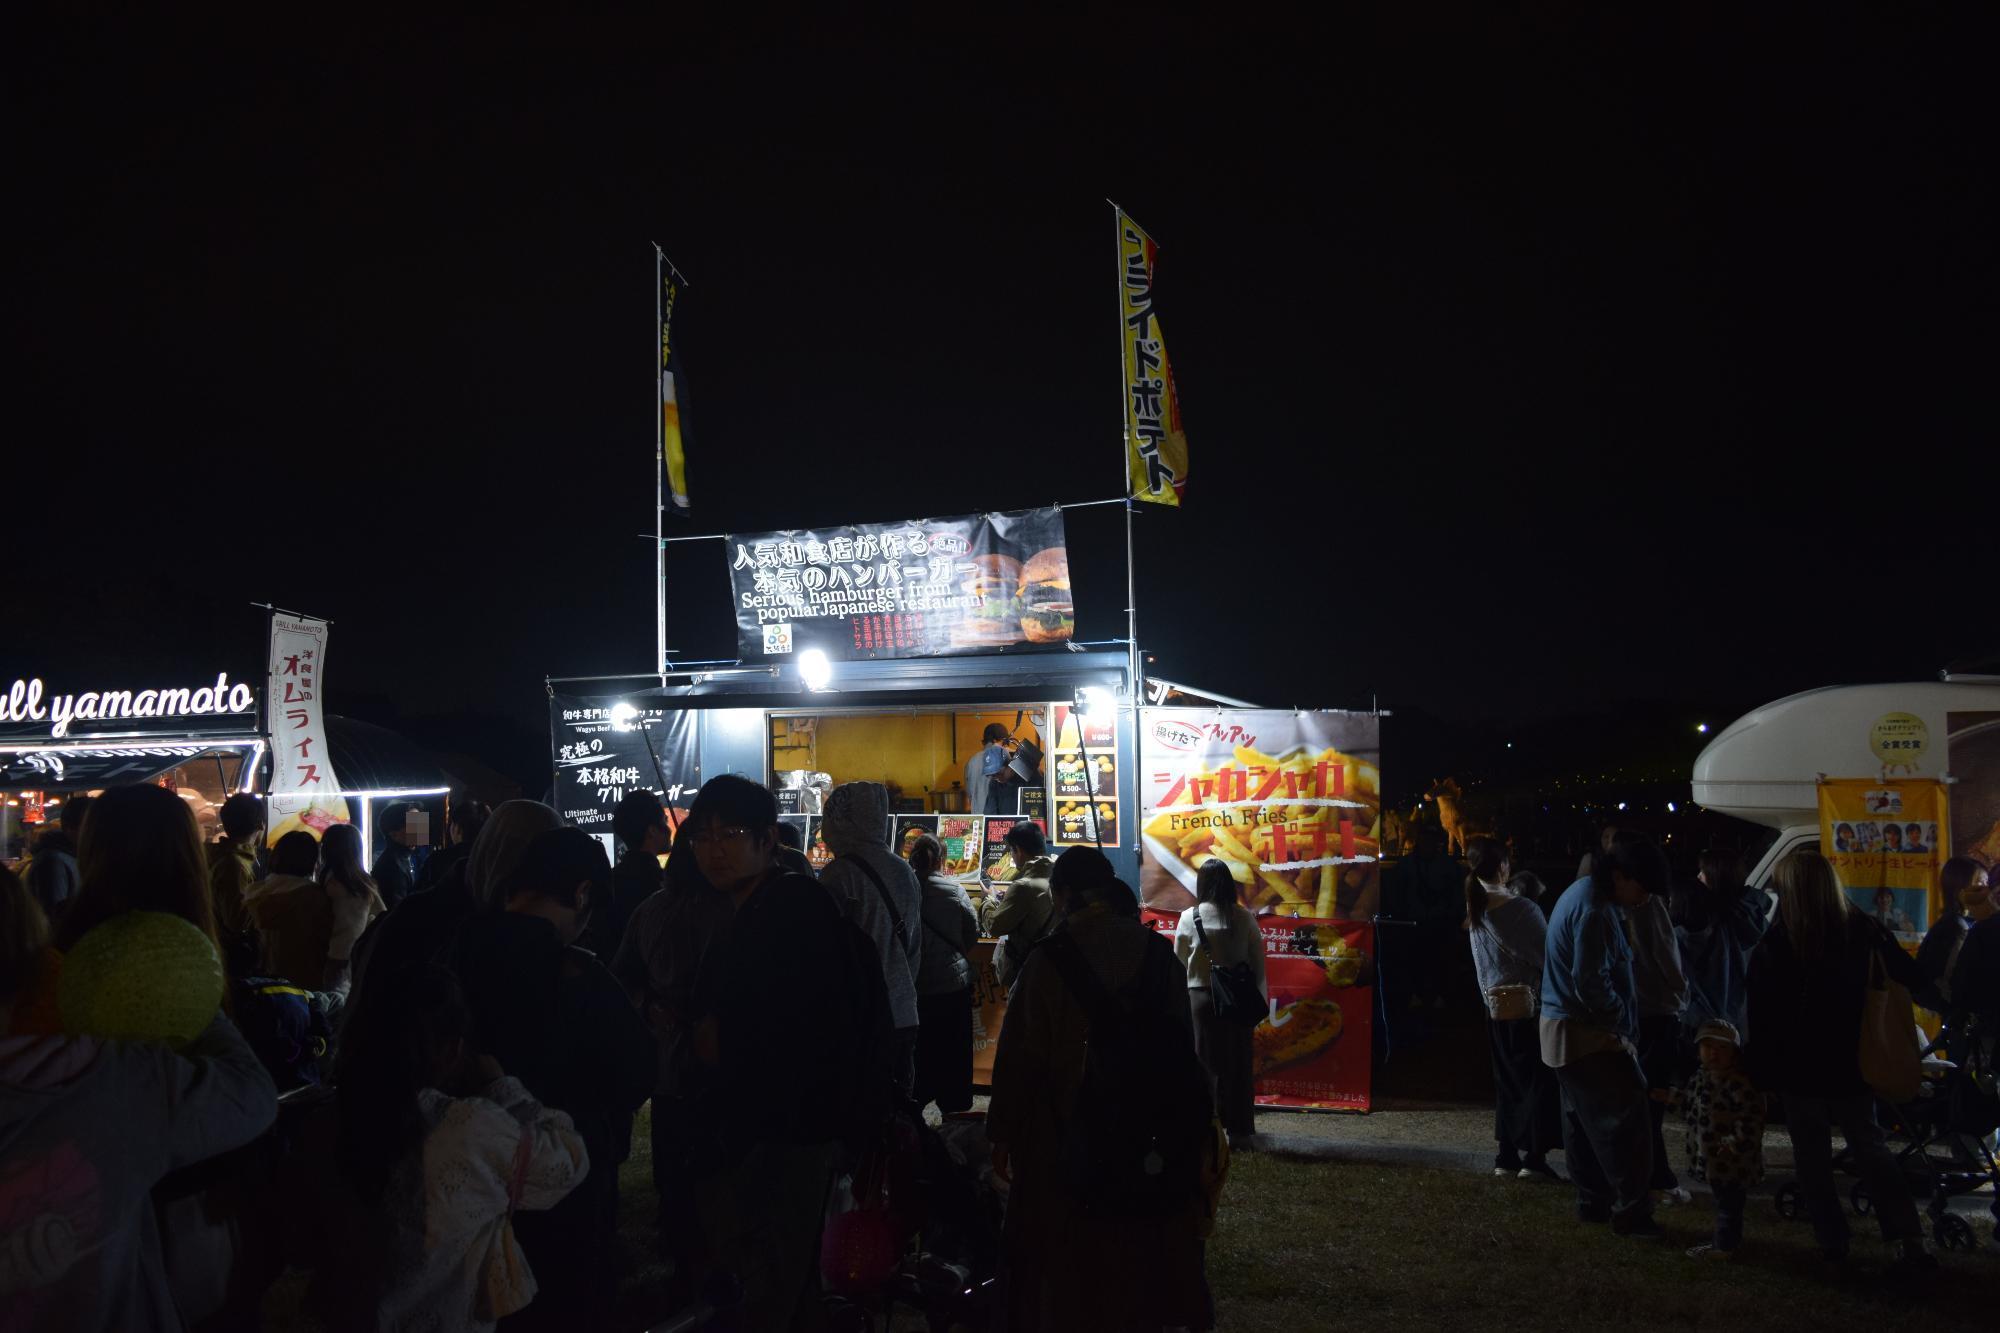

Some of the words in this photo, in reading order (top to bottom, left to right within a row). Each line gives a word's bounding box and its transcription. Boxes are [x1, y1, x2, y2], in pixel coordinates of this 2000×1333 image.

[1126, 228, 1175, 496] フライドポテト
[733, 531, 930, 570] 人気和食店が作る
[753, 554, 978, 595] 本気のハンバーガー
[741, 592, 805, 609] Serious
[810, 585, 903, 605] hamburger
[908, 581, 952, 597] from
[757, 605, 819, 624] popular
[820, 600, 895, 619] Japanese
[900, 592, 987, 612] restaurant
[51, 671, 254, 738] yamamoto
[283, 654, 321, 787] オムライス
[575, 726, 596, 734] Wagyu
[1156, 726, 1201, 747] 揚げたて
[560, 739, 603, 760] 究極の
[576, 766, 640, 785] 本格和牛
[1154, 761, 1345, 807] シャカシャカ
[564, 808, 598, 819] Ultimate
[576, 814, 606, 825] WAGYU
[1170, 810, 1233, 831] French
[1242, 808, 1288, 826] Fries
[1261, 820, 1372, 864] ポテト
[1829, 855, 1940, 869] サントリー生ビール
[1266, 941, 1338, 956] 贅沢スイーツ
